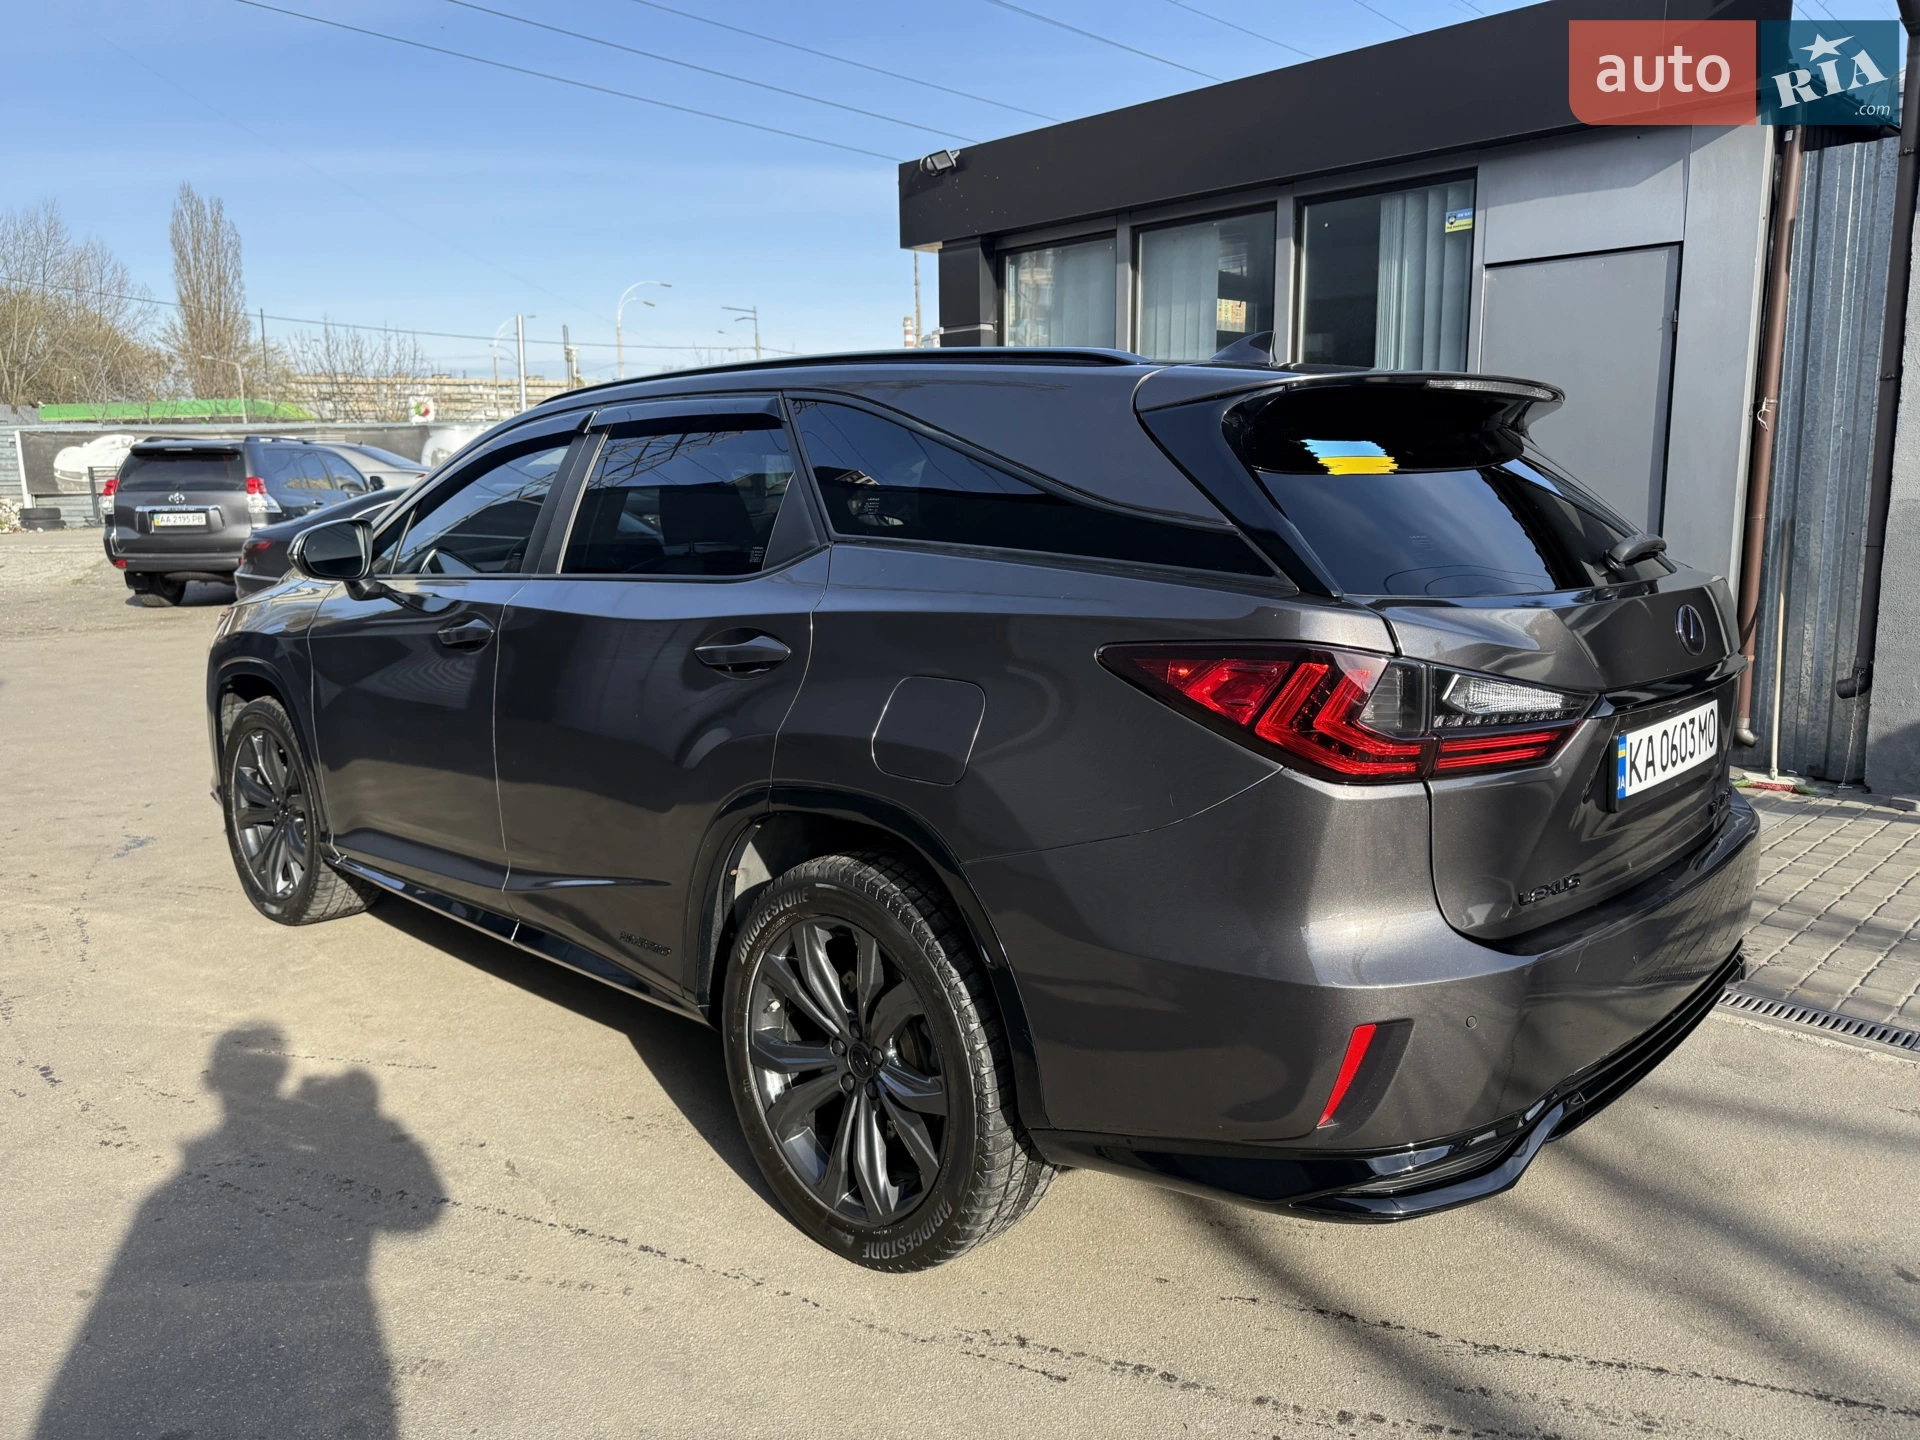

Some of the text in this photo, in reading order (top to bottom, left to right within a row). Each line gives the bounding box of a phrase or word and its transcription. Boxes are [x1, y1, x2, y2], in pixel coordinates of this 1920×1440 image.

[1518, 873, 1581, 906] LEXUS
[737, 886, 810, 965] BRIDGESTONE
[861, 1195, 953, 1260] BRIDGESTONE
